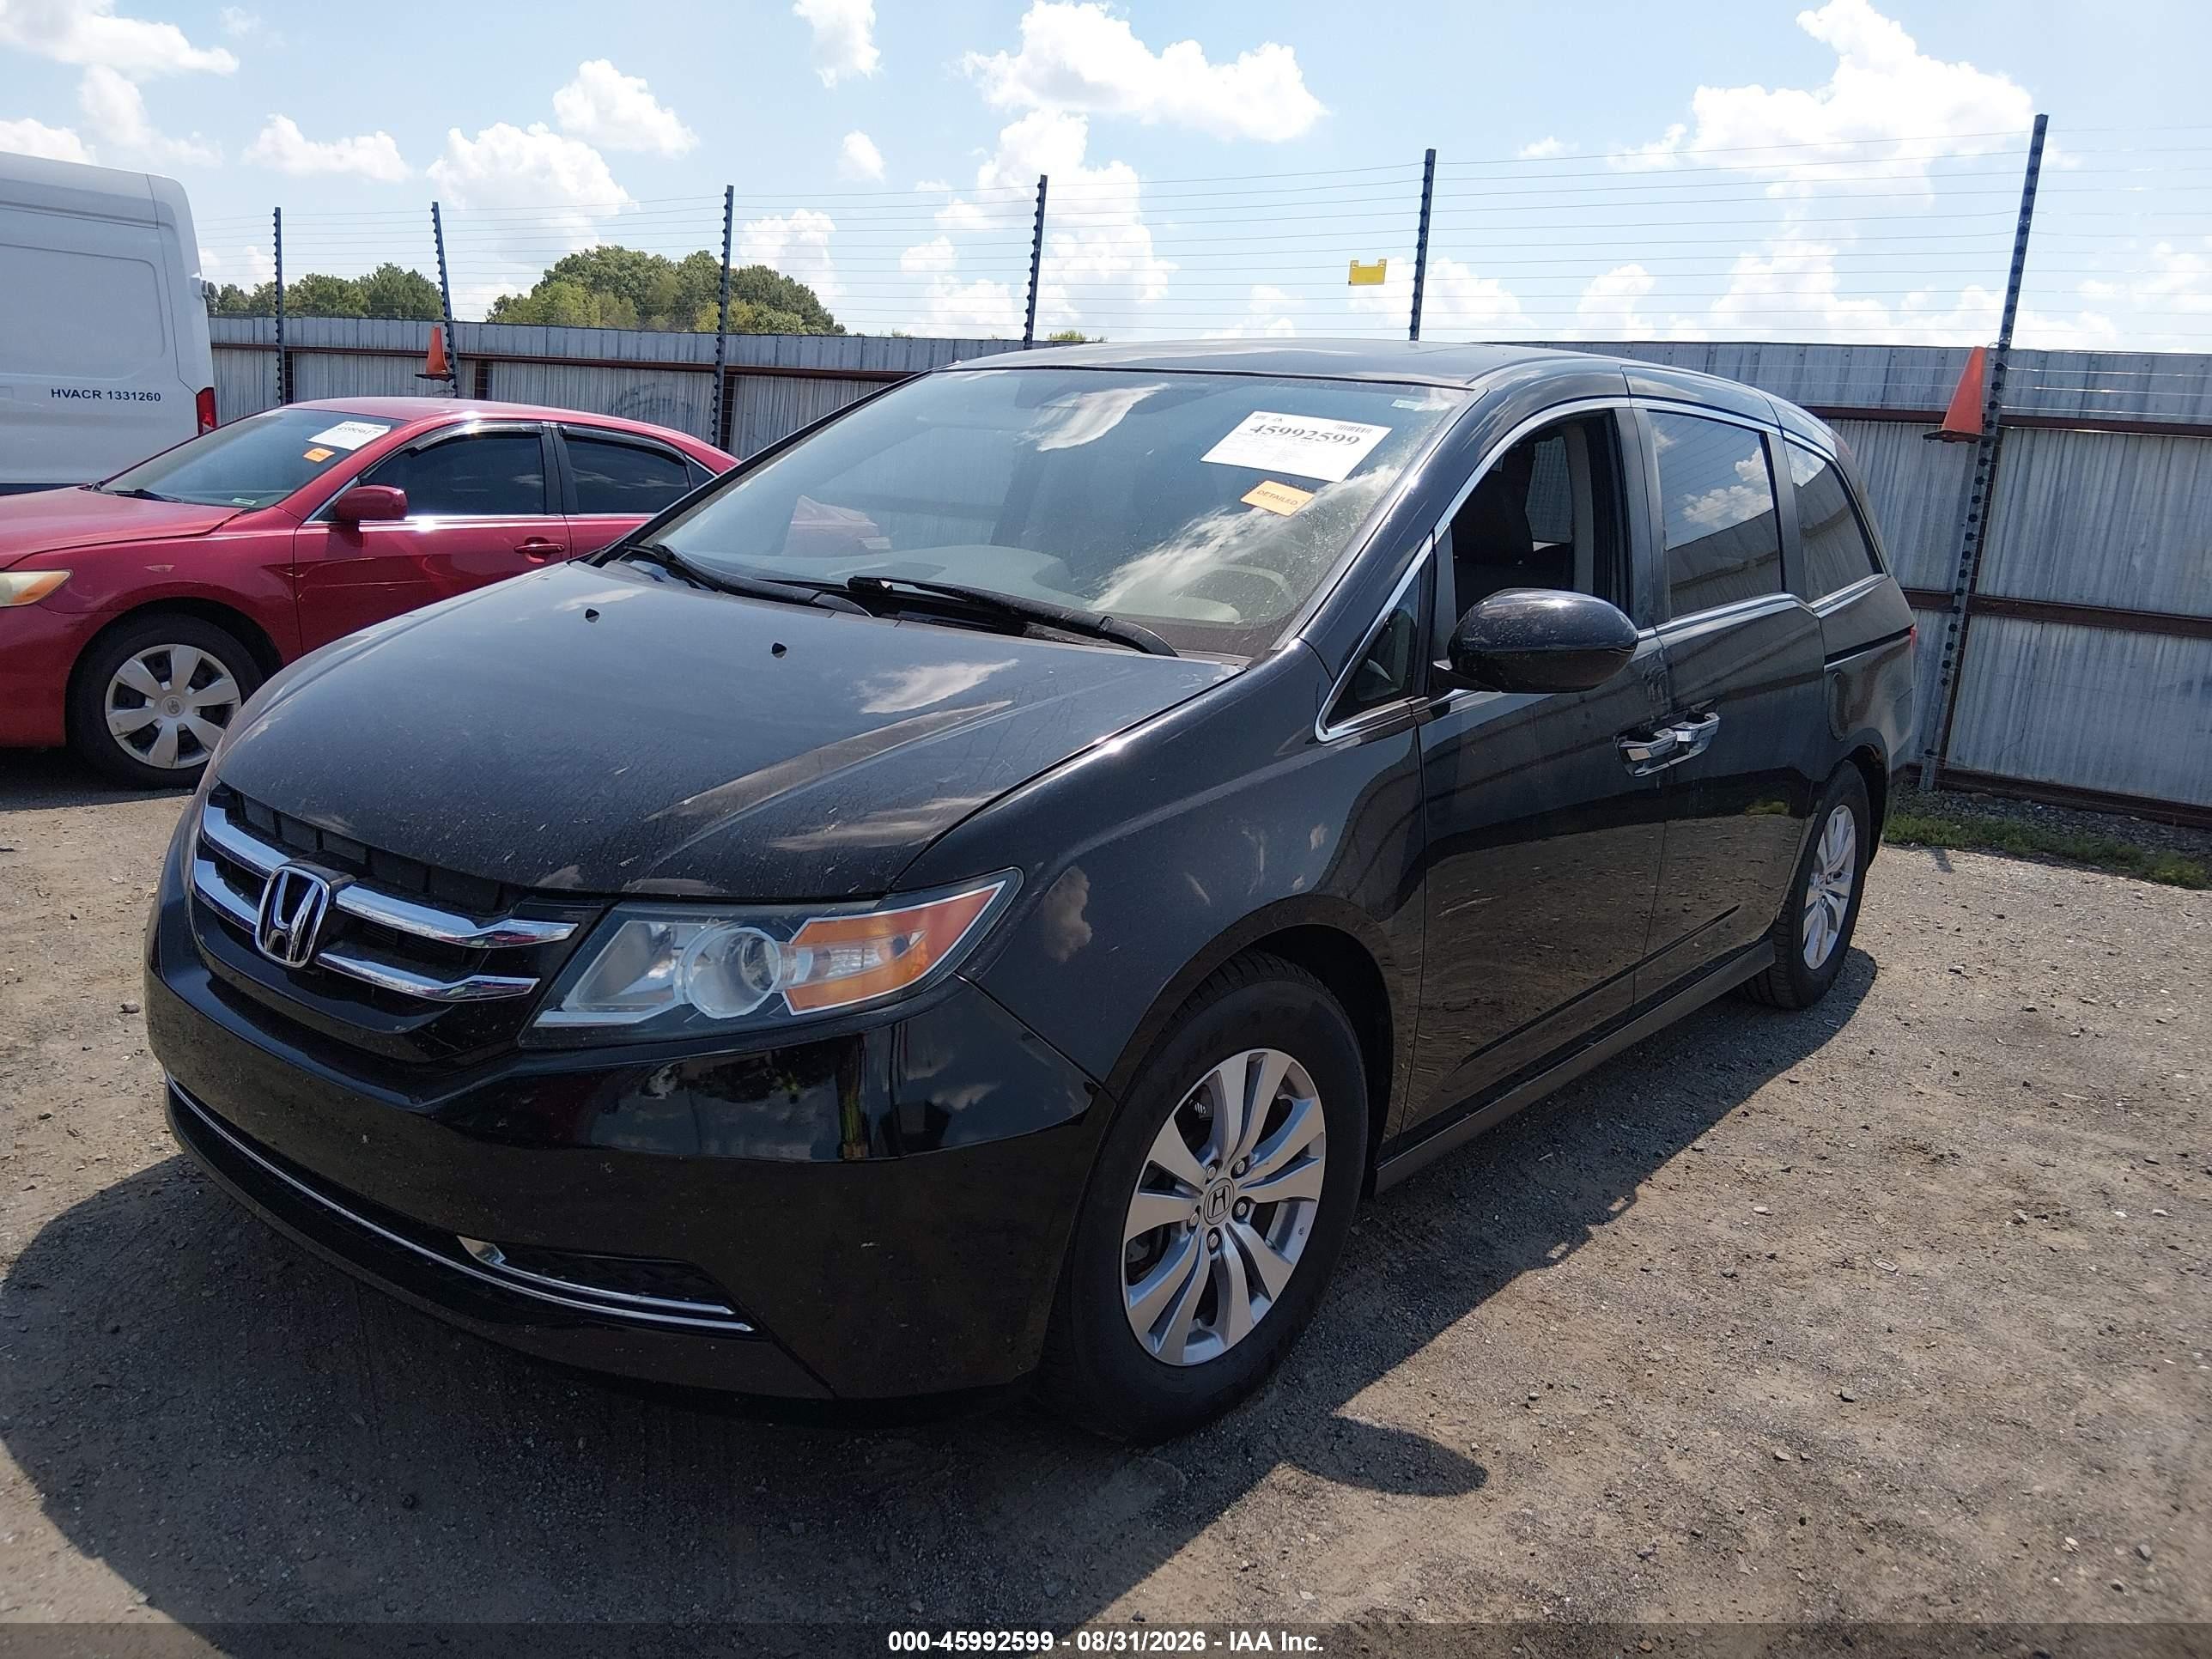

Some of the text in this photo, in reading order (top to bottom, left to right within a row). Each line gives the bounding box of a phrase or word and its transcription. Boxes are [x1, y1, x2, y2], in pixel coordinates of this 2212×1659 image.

[51, 388, 161, 402] HVACR 1331260
[1249, 424, 1361, 446] 45992599
[1256, 489, 1298, 506] DETAILED
